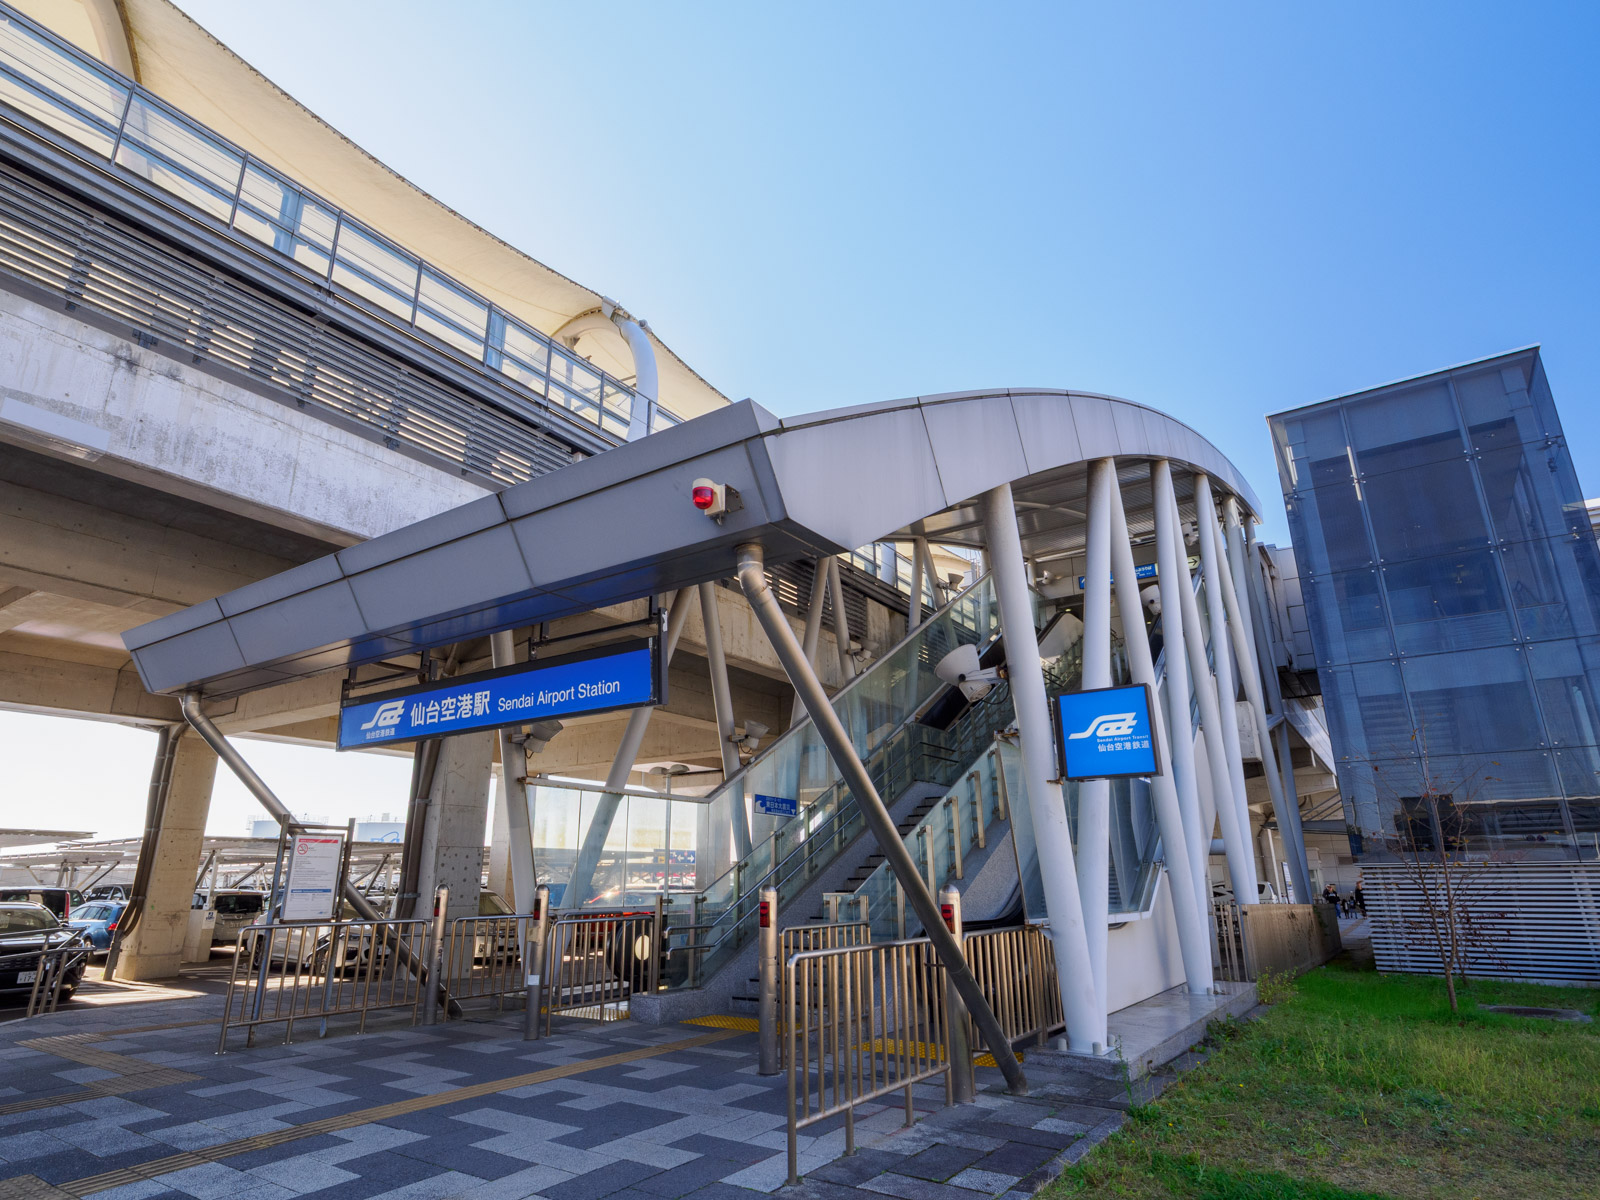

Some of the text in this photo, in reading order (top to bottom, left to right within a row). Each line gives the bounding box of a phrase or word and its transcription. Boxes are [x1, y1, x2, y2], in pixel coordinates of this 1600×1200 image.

[497, 679, 621, 712] Sendai Airport Station
[410, 690, 491, 727] 仙台空港駅
[366, 728, 395, 739] 仙台空港鉄道
[1098, 740, 1149, 752] 仙台空港鉄道
